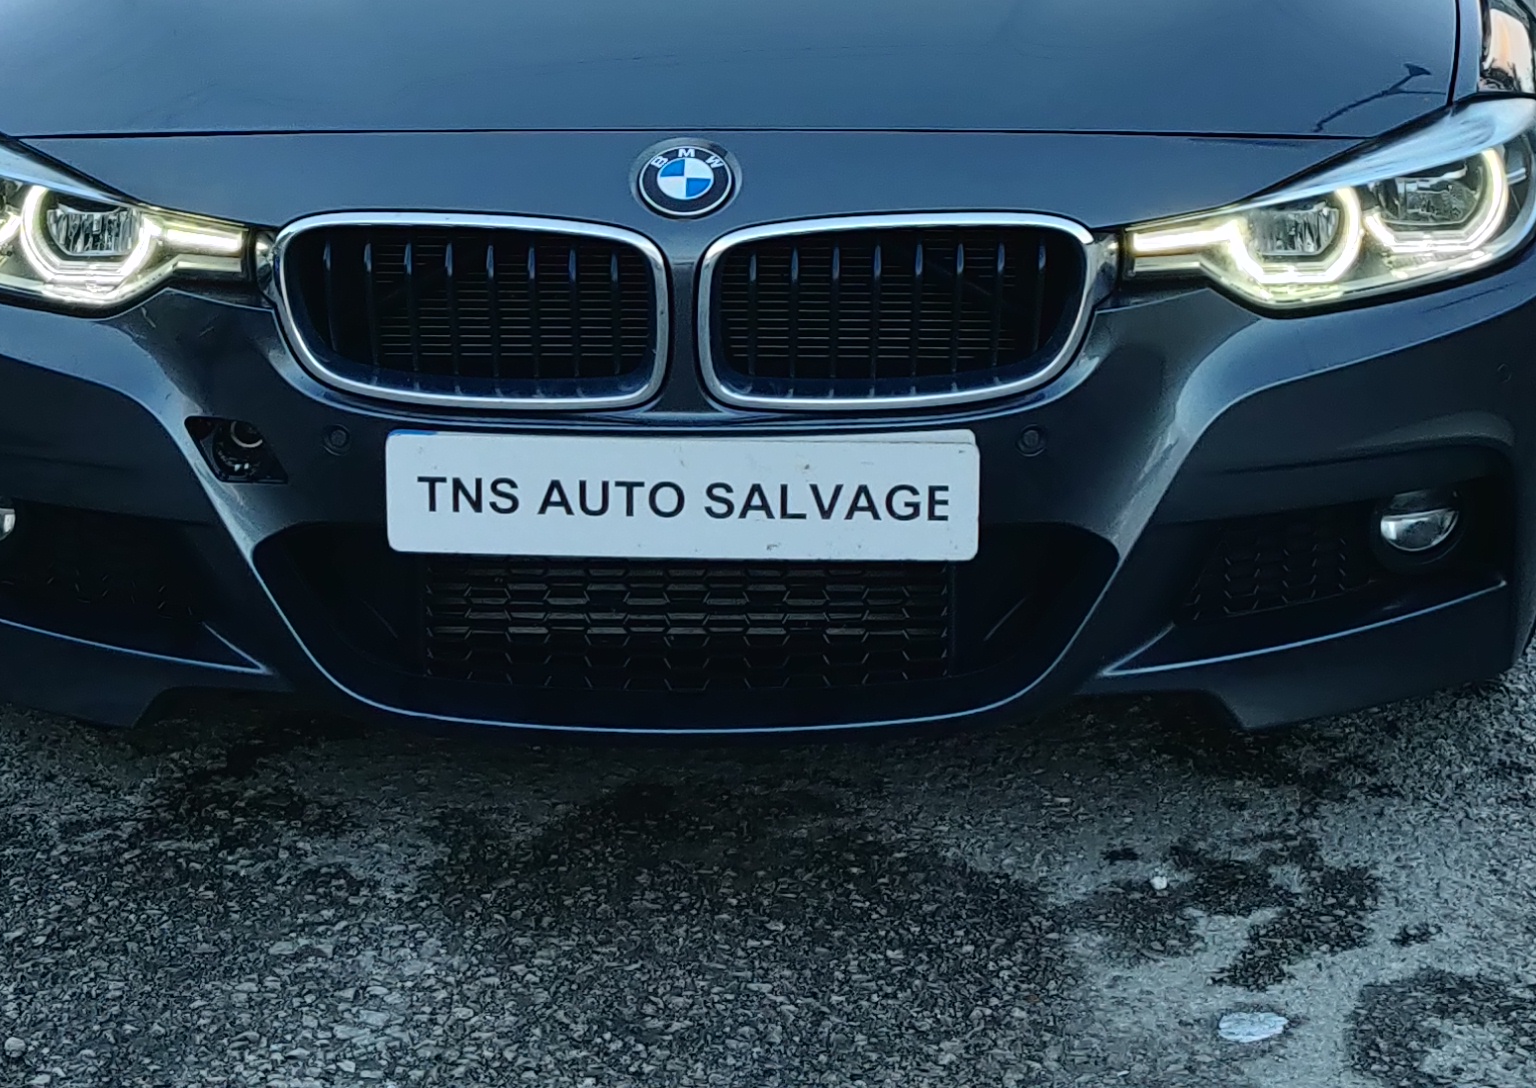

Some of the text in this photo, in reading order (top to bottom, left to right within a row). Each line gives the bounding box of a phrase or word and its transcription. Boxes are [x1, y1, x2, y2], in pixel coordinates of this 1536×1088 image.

[650, 147, 725, 170] BMW
[417, 476, 949, 522] TNS AUTO SALVAGE
